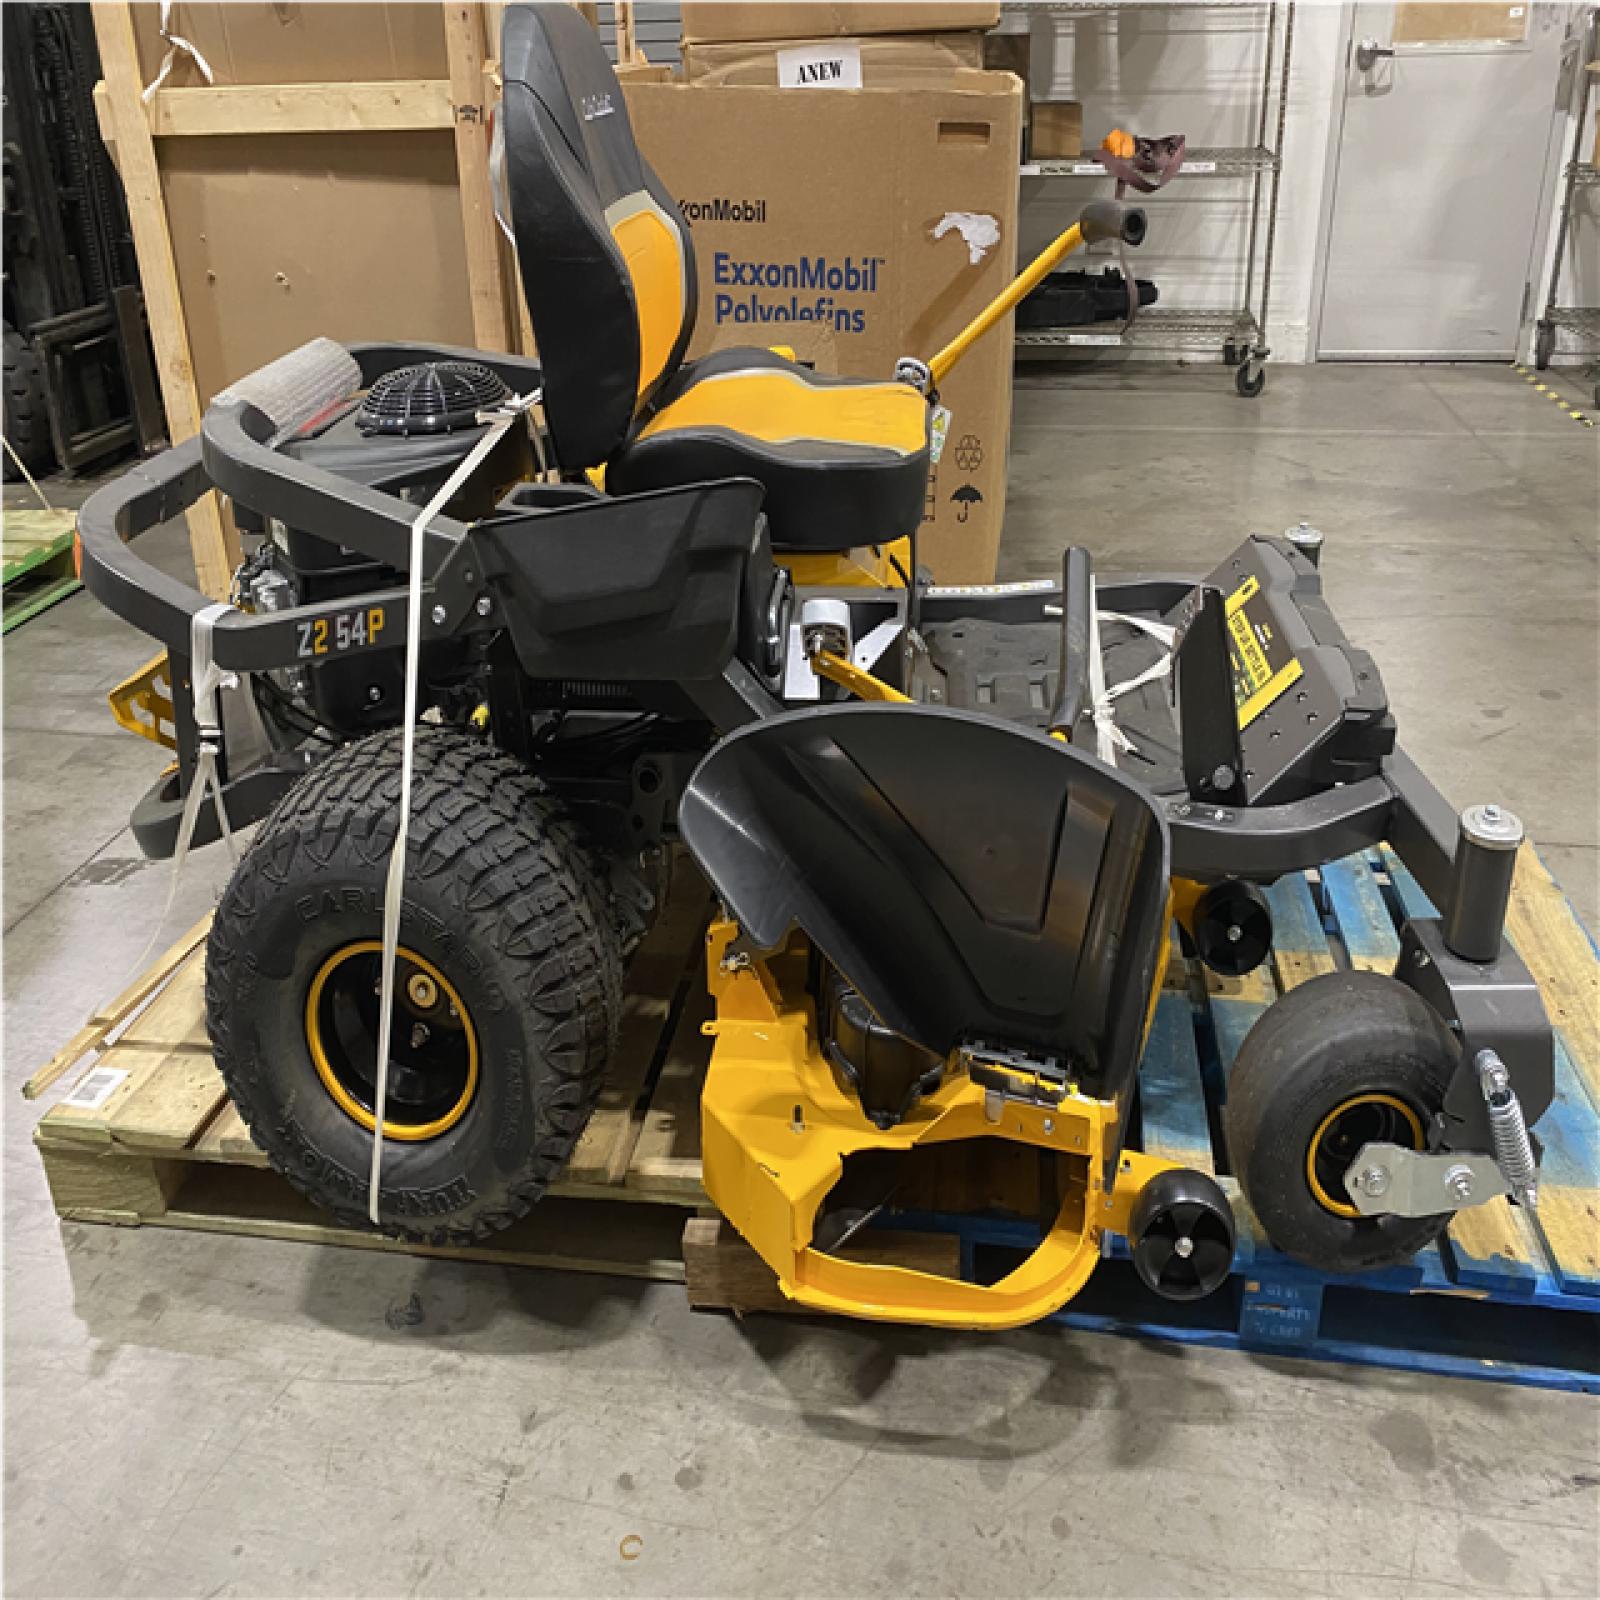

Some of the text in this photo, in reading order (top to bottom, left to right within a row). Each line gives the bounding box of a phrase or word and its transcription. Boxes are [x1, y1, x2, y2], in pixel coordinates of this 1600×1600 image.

[797, 60, 842, 84] ANEW
[714, 252, 877, 292] ExxonMobil
[297, 607, 384, 657] Z2 54P
